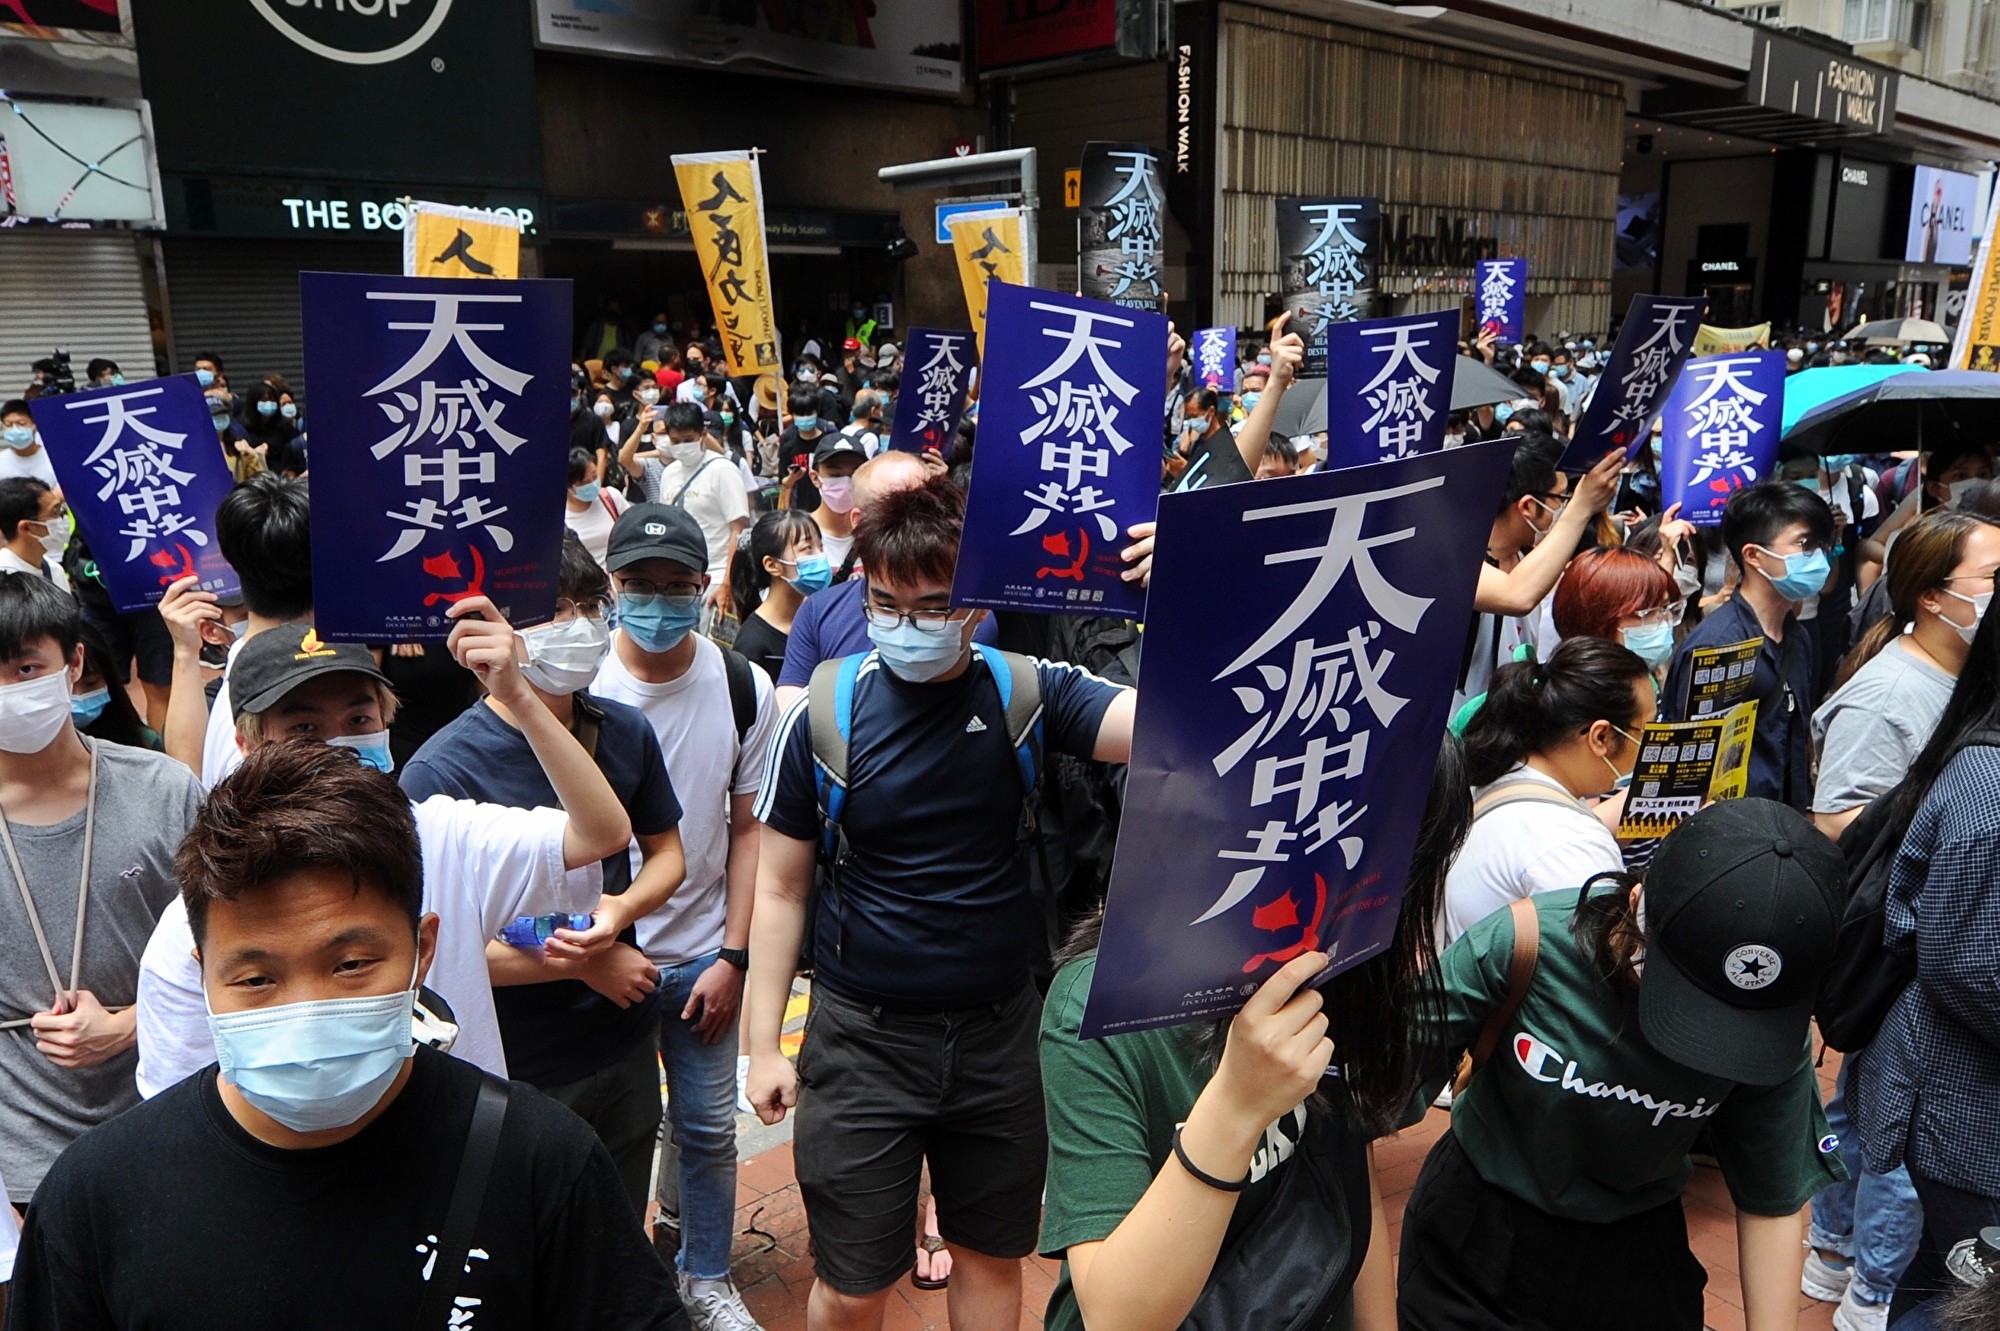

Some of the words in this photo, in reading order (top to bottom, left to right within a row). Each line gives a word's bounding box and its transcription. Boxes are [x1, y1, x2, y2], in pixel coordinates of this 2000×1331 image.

[1178, 45, 1191, 122] FASHION
[1828, 60, 1876, 97] FASHION
[1847, 94, 1876, 126] WALK
[1177, 125, 1189, 173] WALK
[1842, 167, 1868, 186] CHANEL
[282, 199, 351, 229] THE
[1104, 152, 1160, 298] 天滅中共
[1921, 203, 1966, 232] CHANEL
[1299, 204, 1367, 336] 天滅中共
[1702, 262, 1739, 271] CHANEL
[1978, 294, 1998, 341] POWER
[911, 334, 966, 433] 天滅中共
[1600, 304, 1696, 435] 天滅中共
[362, 292, 535, 563] 天滅中共
[1009, 301, 1140, 542] 天滅中共
[1684, 357, 1768, 487] 天滅中共
[65, 387, 208, 562] 天滅中共
[1189, 476, 1445, 926] 天滅中共
[1730, 971, 1742, 983] ALL
[1744, 977, 1766, 986] STAR
[1735, 949, 1776, 966] CONVERSE
